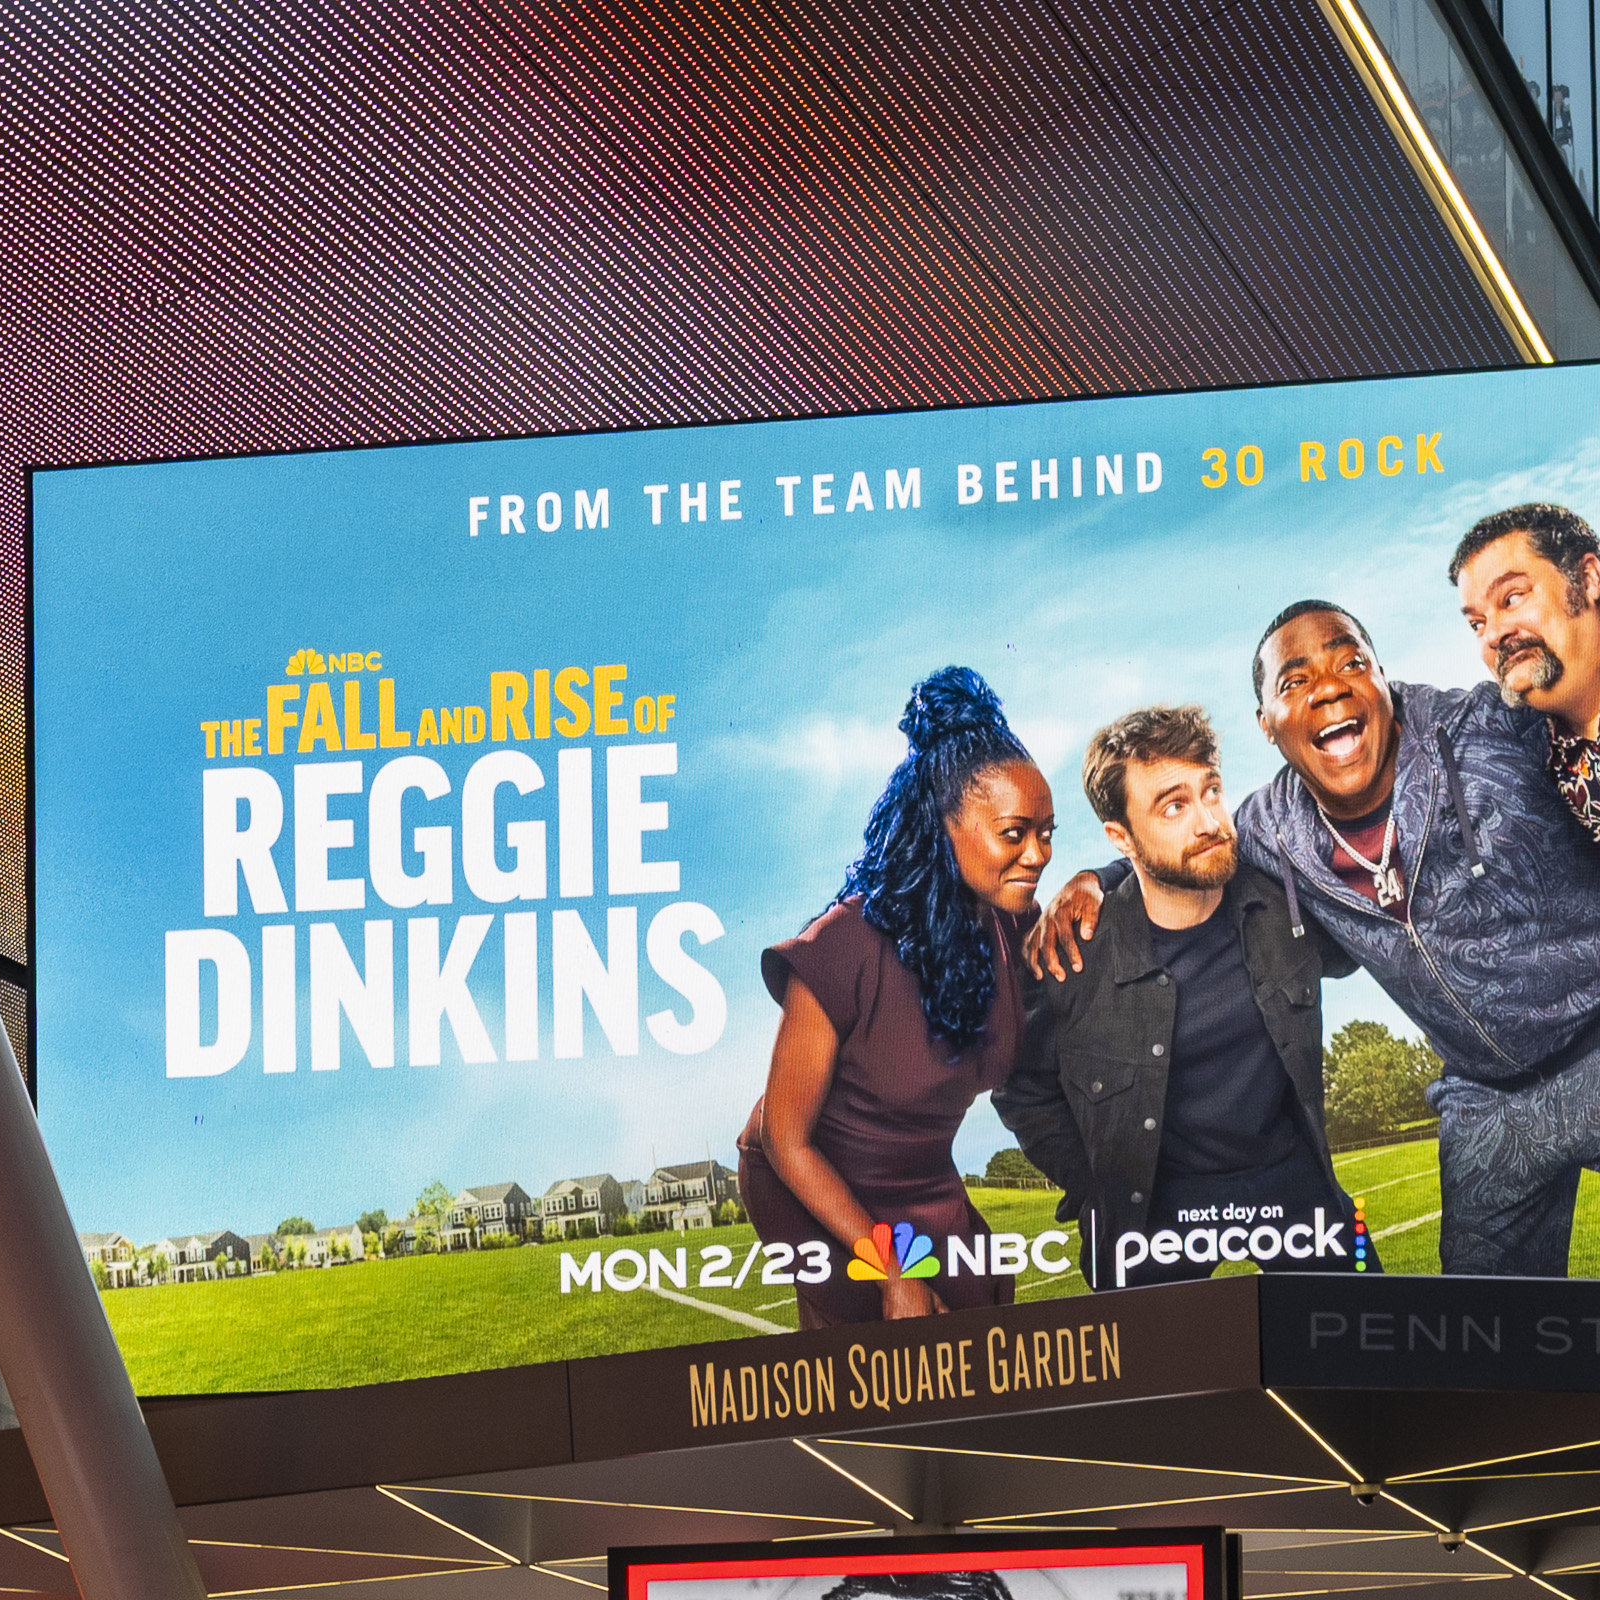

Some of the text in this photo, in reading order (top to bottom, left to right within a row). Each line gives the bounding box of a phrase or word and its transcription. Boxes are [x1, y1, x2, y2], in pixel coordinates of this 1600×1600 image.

[469, 431, 1447, 537] FROM THE TEAM BEHIND 30 ROCK
[328, 651, 383, 673] NBC
[200, 664, 676, 758] THE FALL AND RISE OF
[202, 742, 681, 918] REGGIE
[1373, 867, 1404, 908] 24
[164, 900, 727, 1079] DINKINS
[559, 1208, 1349, 1294] MON 2/23 NBC peacock
[1177, 1203, 1285, 1225] next day on
[689, 1321, 1123, 1428] MADISON SQUARE GARDEN
[1310, 1311, 1501, 1353] PENN
